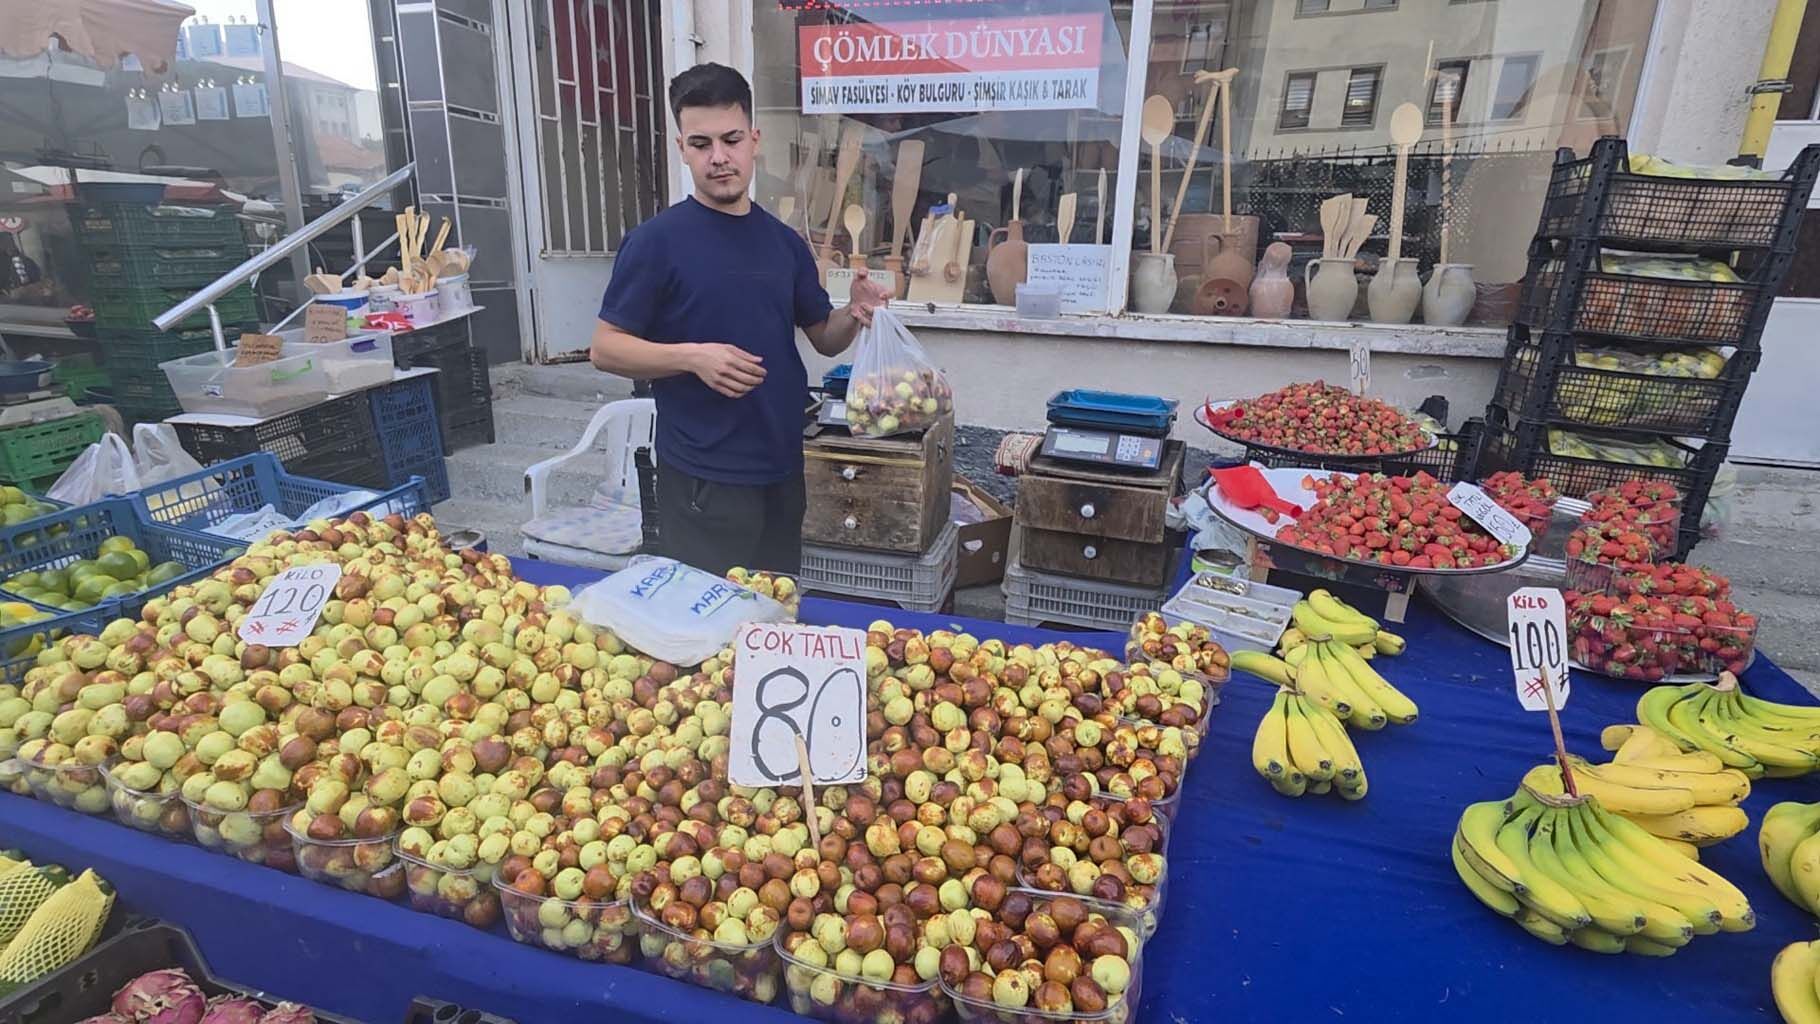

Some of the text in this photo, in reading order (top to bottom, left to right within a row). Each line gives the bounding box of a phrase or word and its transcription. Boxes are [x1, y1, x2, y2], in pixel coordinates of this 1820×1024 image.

[814, 24, 1087, 72] ÇÖMLEK DÜNYASI
[842, 79, 889, 105] FASÜLYESİ
[897, 78, 916, 103] KÖY
[919, 82, 965, 103] BULGURU
[1052, 78, 1087, 100] TARAK
[252, 583, 325, 619] 120
[1511, 619, 1561, 671] 100
[751, 665, 863, 783] 80
